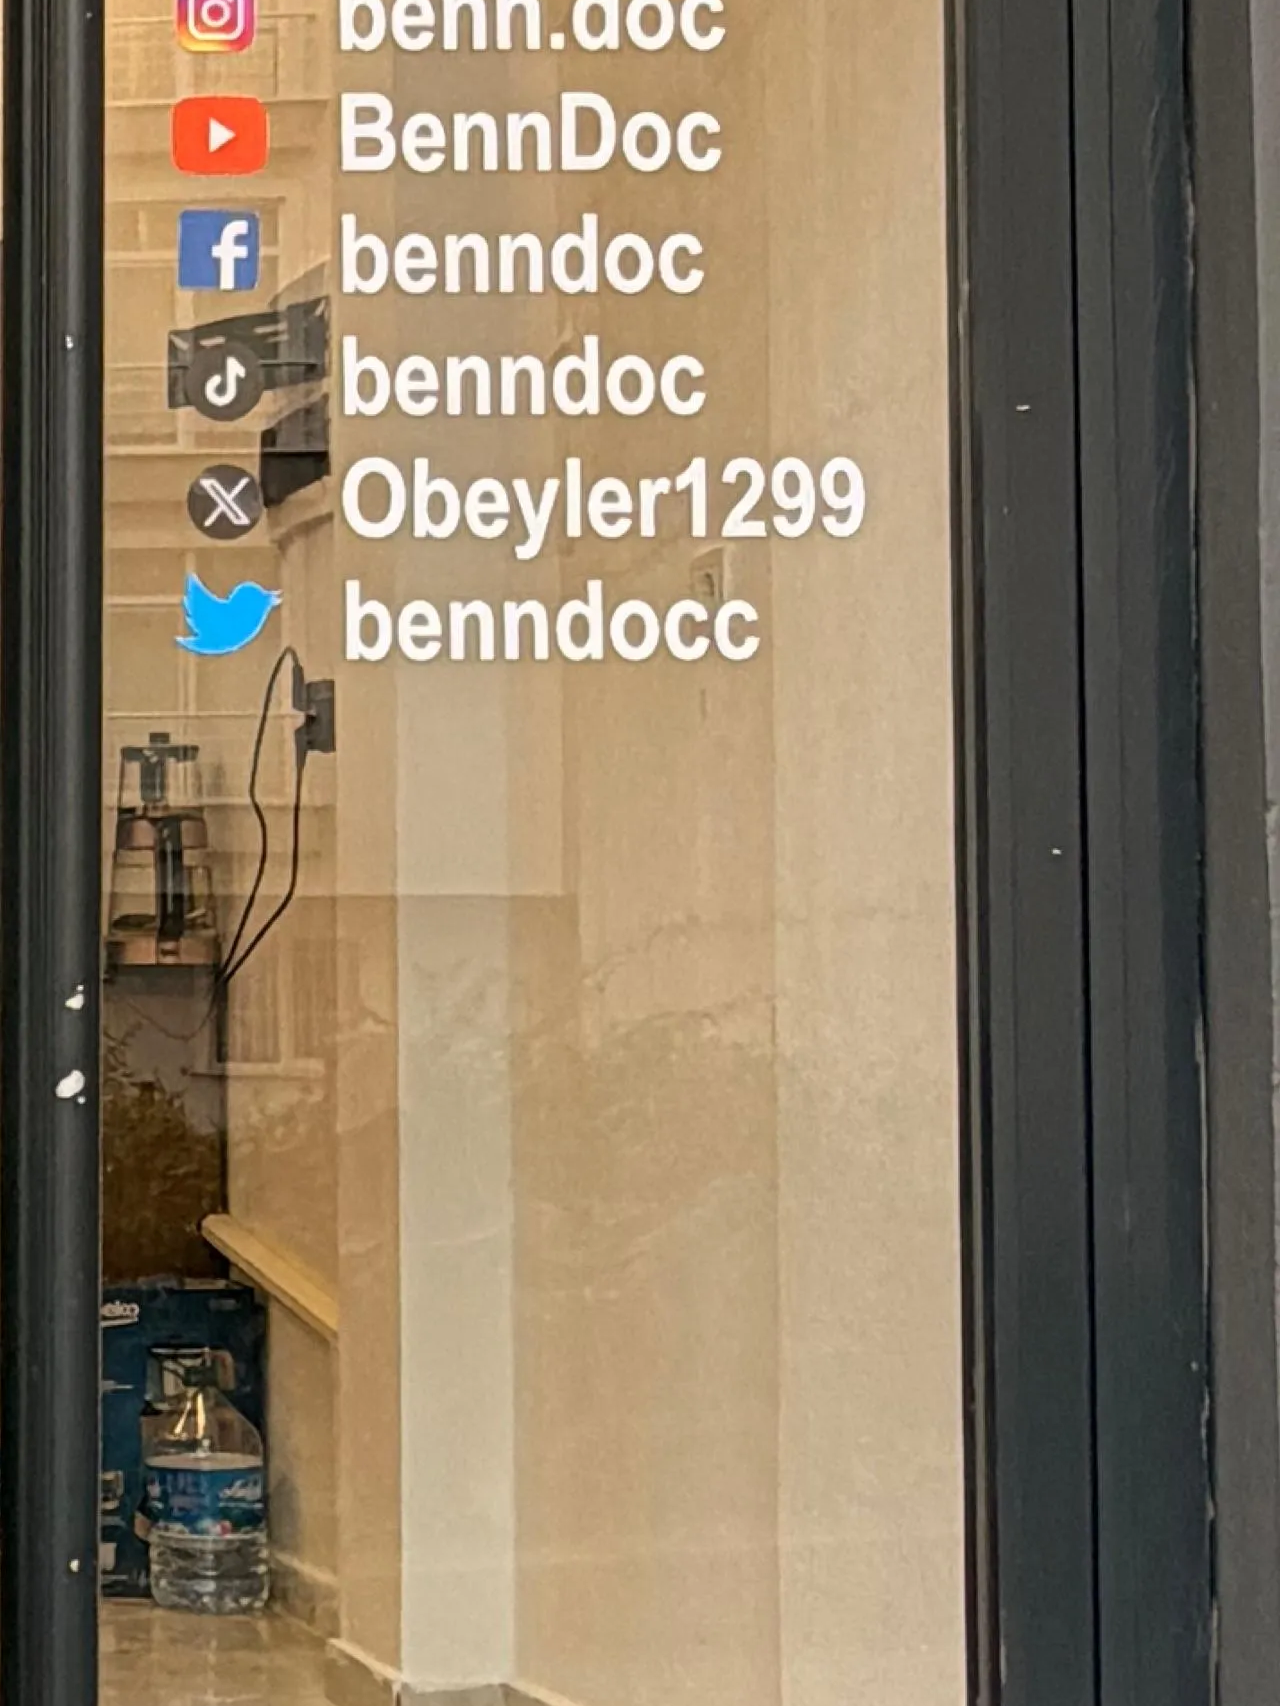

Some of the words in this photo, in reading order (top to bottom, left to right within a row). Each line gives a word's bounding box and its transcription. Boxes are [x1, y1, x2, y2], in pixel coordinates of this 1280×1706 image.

[342, 93, 721, 171] BennDoc
[341, 214, 704, 294] benndoc
[343, 335, 705, 414] benndoc
[343, 457, 866, 560] Obeyler1299
[347, 580, 759, 660] benndocc
